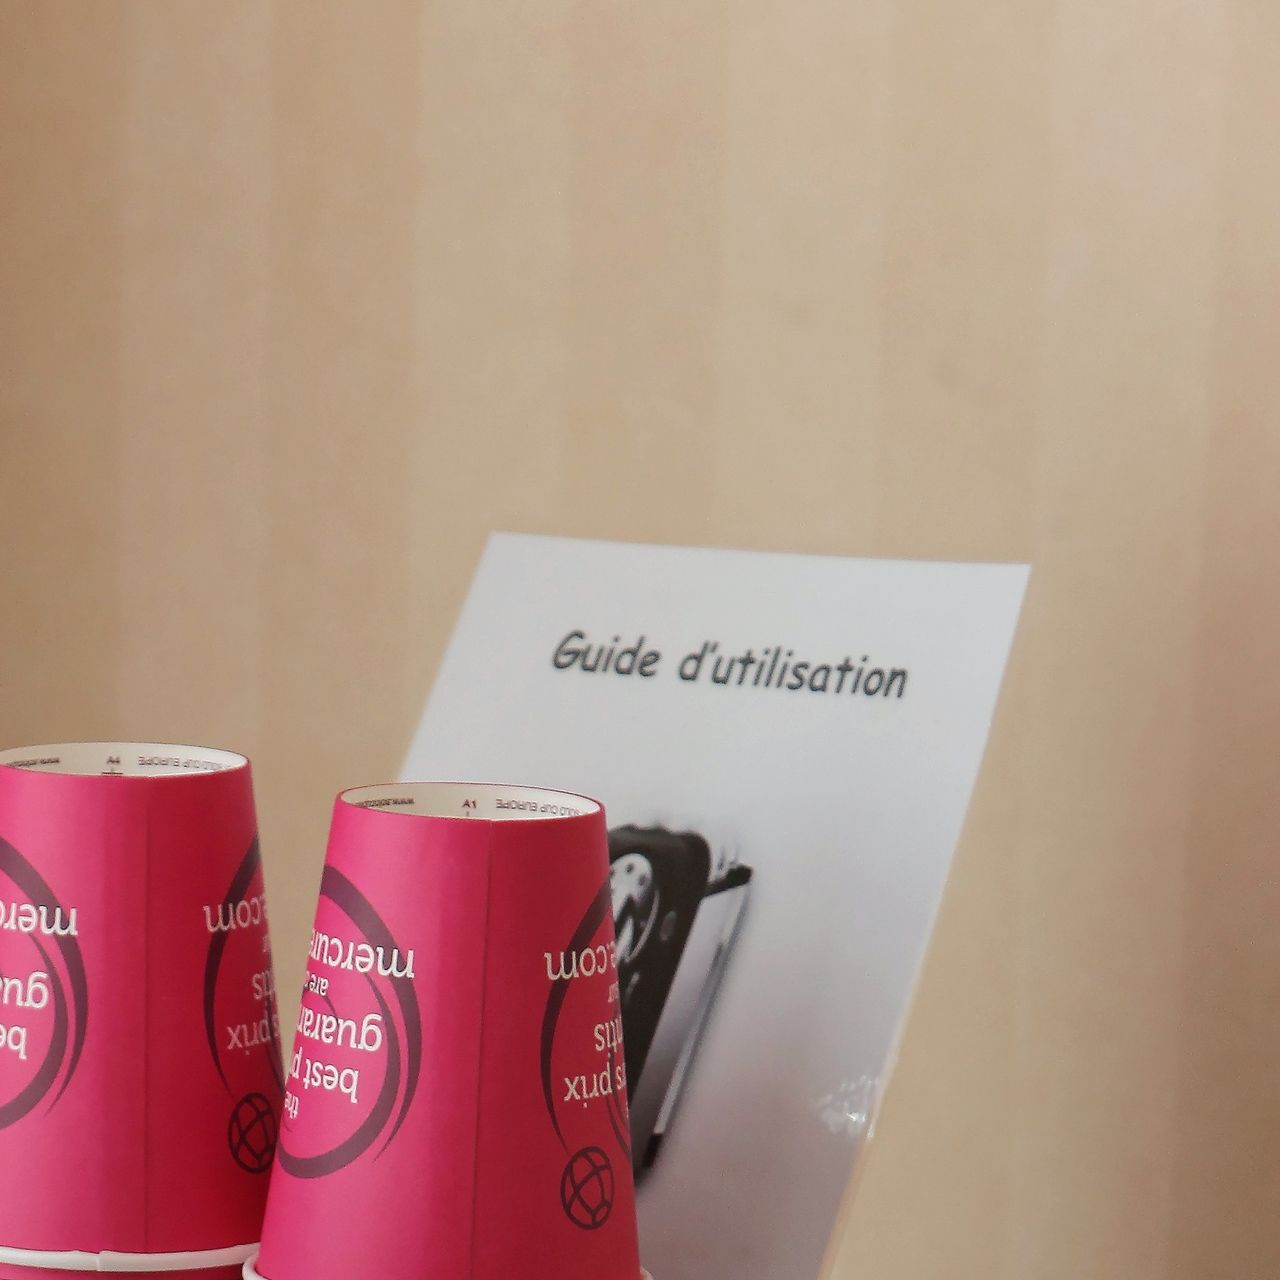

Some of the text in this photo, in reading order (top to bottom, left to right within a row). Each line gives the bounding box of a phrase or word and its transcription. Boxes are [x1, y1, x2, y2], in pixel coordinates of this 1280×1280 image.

[552, 629, 909, 699] Guide d'utilisation
[495, 798, 538, 812] EUROPE
[540, 804, 559, 815] CUP
[310, 976, 330, 997] are
[226, 1009, 271, 1055] prix
[302, 1059, 360, 1105] best
[564, 1062, 613, 1108] prix
[284, 1091, 300, 1120] the
